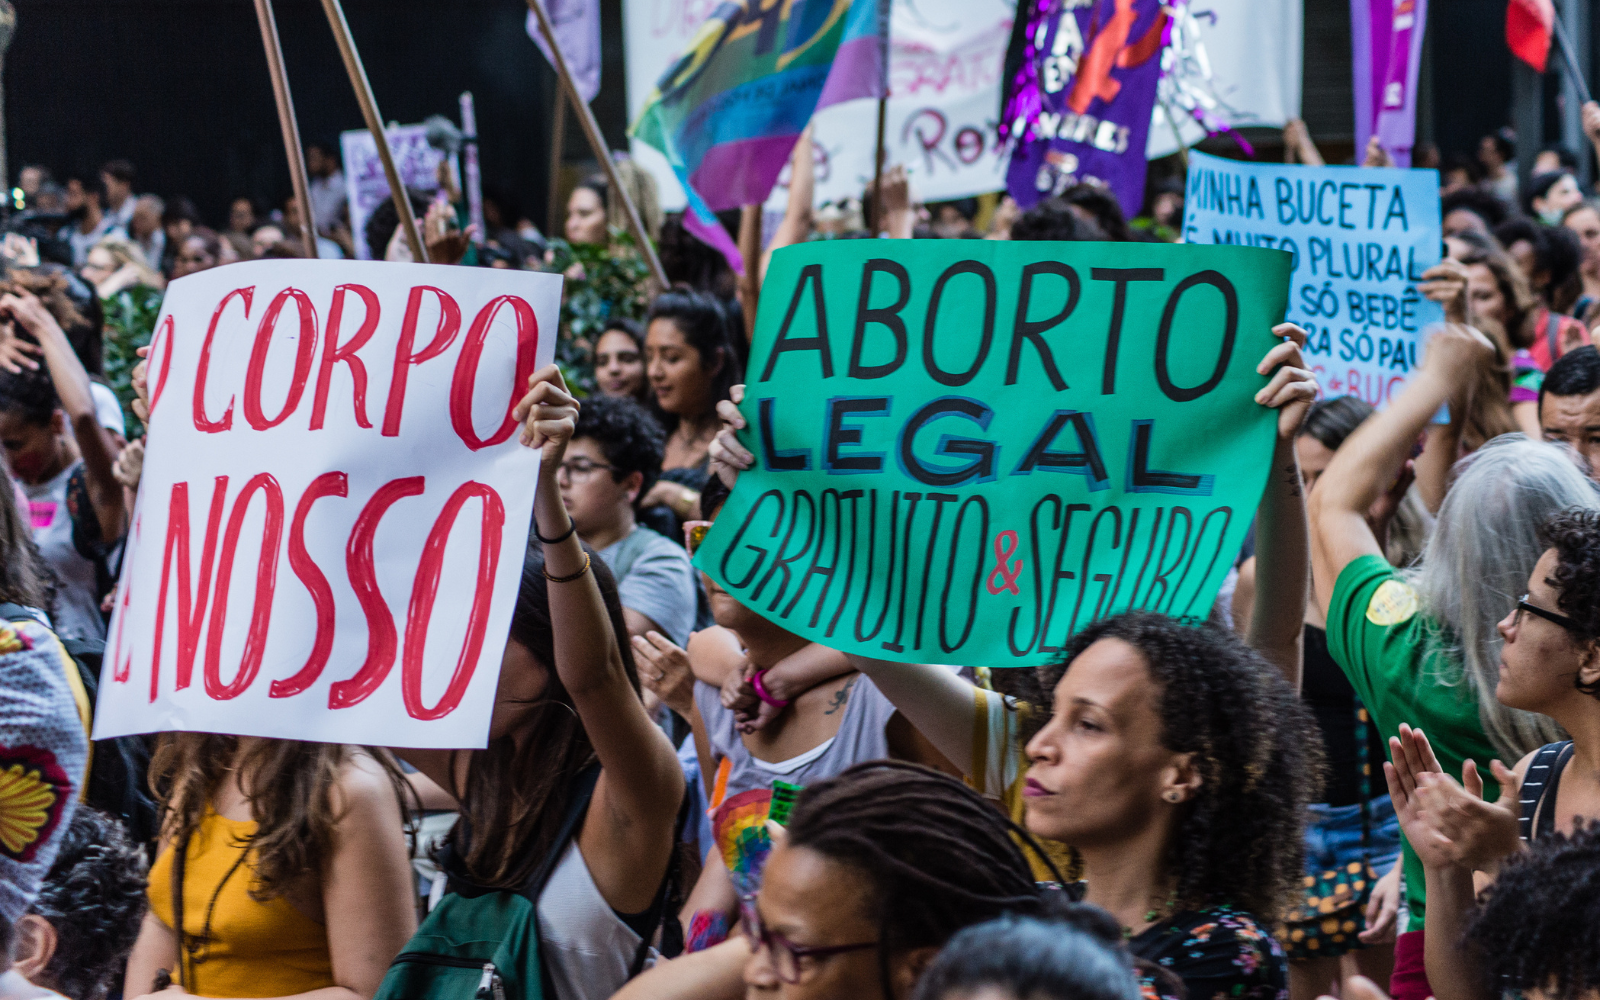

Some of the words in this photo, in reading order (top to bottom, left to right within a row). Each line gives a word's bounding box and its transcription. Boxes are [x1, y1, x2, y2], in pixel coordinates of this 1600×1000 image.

[1275, 176, 1409, 231] BUCETA
[1301, 281, 1339, 319] SÓ
[1347, 286, 1420, 332] BEBÊ
[1308, 236, 1424, 282] PLURAL
[192, 283, 540, 452] CORPO
[759, 258, 1239, 403] ABORTO
[1339, 324, 1374, 362] SÓ
[758, 395, 1216, 496] LEGAL
[148, 470, 506, 721] NOSSO
[720, 488, 989, 654] GRATUITO
[986, 530, 1023, 596] &
[1007, 493, 1232, 657] SEGURO
